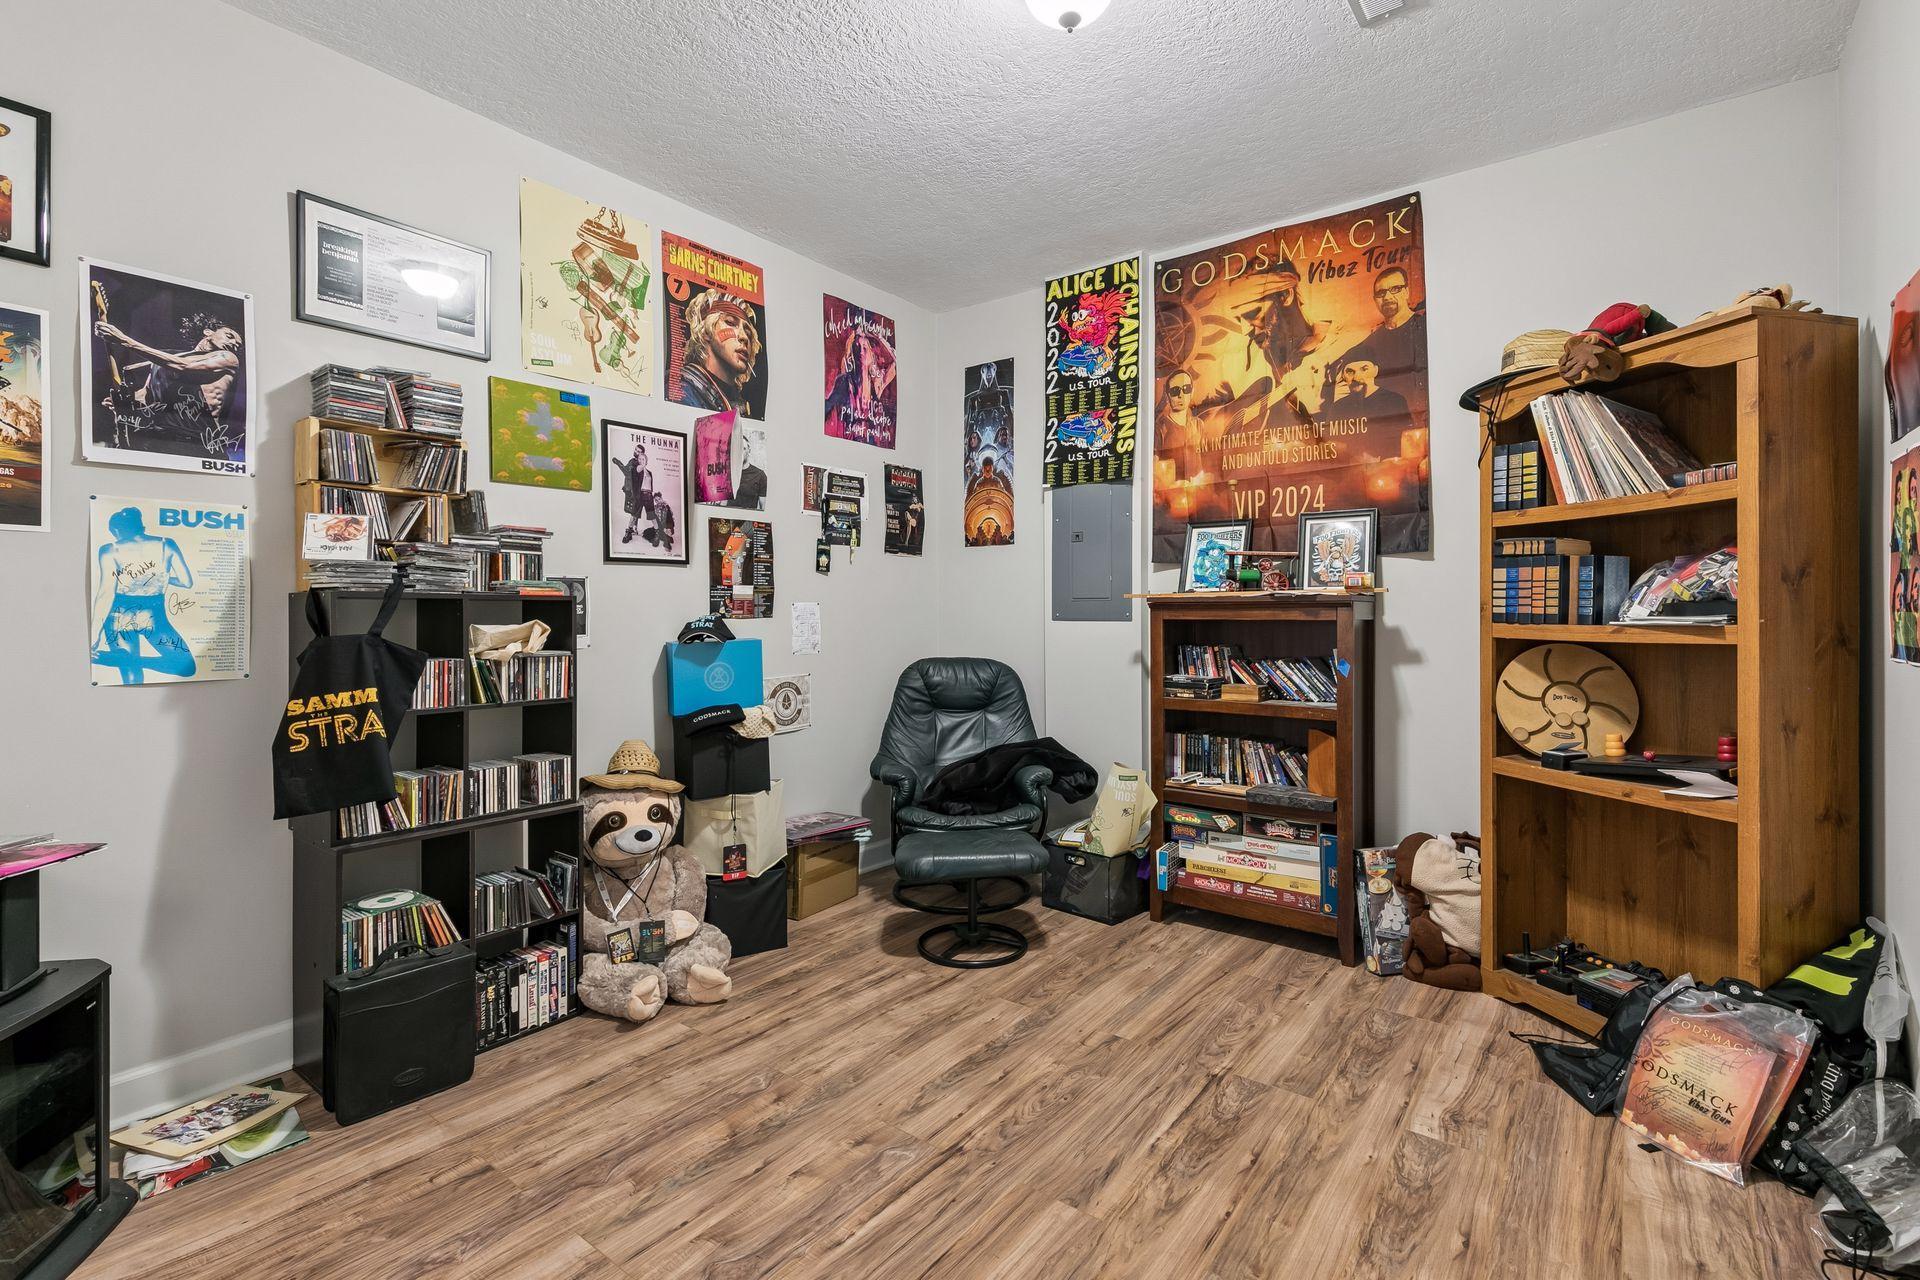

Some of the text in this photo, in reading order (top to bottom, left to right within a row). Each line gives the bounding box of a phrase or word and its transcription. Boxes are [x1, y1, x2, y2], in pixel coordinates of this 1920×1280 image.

[321, 248, 360, 263] benjamin
[322, 241, 359, 258] breaking
[1161, 207, 1411, 294] GODSMACK
[669, 243, 759, 293] BARNS COURTNEY
[1308, 245, 1412, 284] Vibez Tour
[673, 278, 683, 294] 7
[1047, 259, 1139, 302] ALICE IN
[1118, 282, 1140, 382] CHAINS
[530, 332, 558, 350] SOUL
[1087, 377, 1112, 389] TOUR
[631, 433, 646, 444] THE
[651, 437, 679, 449] HUNNA
[1195, 416, 1369, 455] AN INTIMATE EVENING OF MUSIC
[1086, 449, 1112, 460] TOUR
[1222, 442, 1337, 471] AND UNTOLD STORIES
[201, 460, 246, 474] BUSH
[707, 461, 728, 476] BUSH
[1233, 484, 1326, 520] VIP 2024
[159, 508, 245, 531] BUSH
[1197, 532, 1209, 541] FOO
[690, 621, 714, 629] STRAT
[287, 688, 379, 717] SAMM
[692, 709, 731, 723] GODSMACK
[288, 709, 388, 753] STRA
[1265, 822, 1295, 836] Yahtzee
[1192, 863, 1227, 874] PARCHEESI
[1226, 856, 1268, 870] MONOPOLY
[1194, 877, 1231, 892] MONOPOLY
[1670, 1015, 1753, 1057] GODSMACK
[1630, 1053, 1739, 1117] GODSMACK
[1688, 1096, 1732, 1126] Vibez Tour
